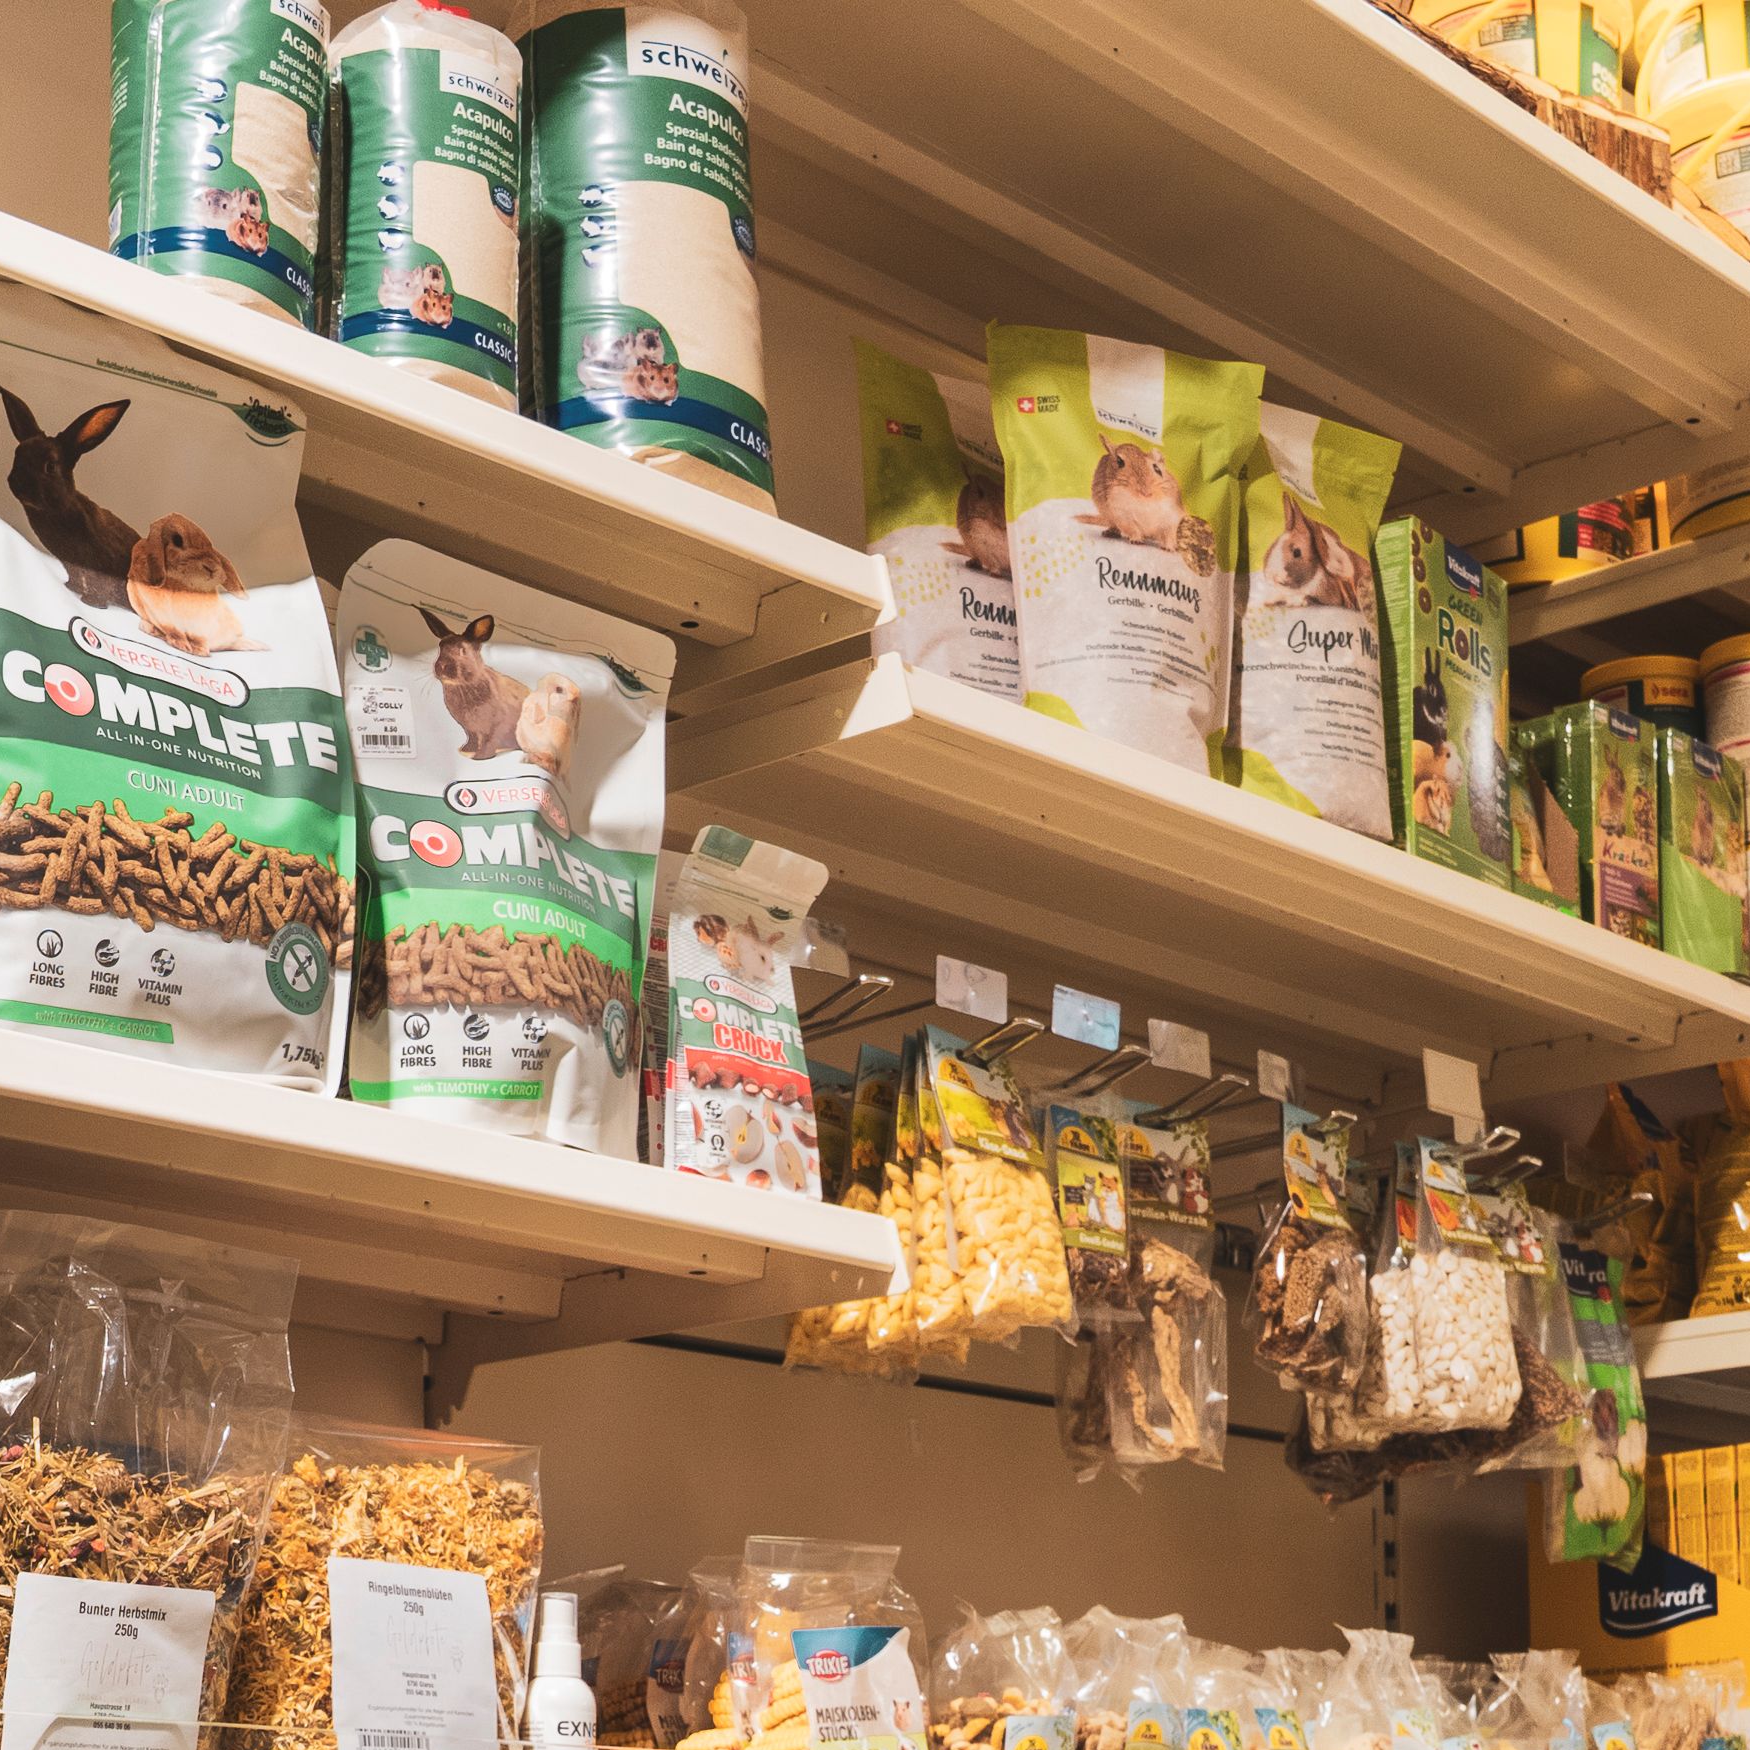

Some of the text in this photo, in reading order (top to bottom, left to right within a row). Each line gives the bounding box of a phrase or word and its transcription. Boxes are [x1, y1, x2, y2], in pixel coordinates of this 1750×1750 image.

[449, 74, 514, 112] schweizer
[453, 101, 513, 143] Acapulco
[669, 93, 744, 147] Acapulco
[657, 137, 730, 172] Bain de sable
[1037, 396, 1061, 404] SWISS
[1037, 404, 1059, 413] MADE
[1098, 409, 1158, 438] schweizer
[1095, 557, 1202, 614] Rennmaus
[969, 627, 1005, 642] Gerbille
[1437, 607, 1492, 679] Rolls
[2, 650, 338, 775] COMPLETE
[96, 727, 262, 780] ALL-IN-ONE NUTRITION
[370, 815, 635, 922] COMPLETE
[461, 872, 595, 913] ALL-IN-ONE NUTRITION
[493, 901, 587, 940] CUNI ADULT
[32, 962, 64, 976] LONG
[91, 970, 119, 985] HIGH
[29, 973, 65, 989] FIBRES
[89, 982, 118, 998] FIBRE
[138, 978, 183, 996] VITAMIN
[145, 993, 171, 1007] PLUS
[401, 1045, 434, 1057] LONG
[462, 1046, 492, 1058] HIGH
[713, 1022, 788, 1065] CROCK
[399, 1055, 437, 1069] FIBRES
[461, 1057, 493, 1070] FIBRE
[520, 1057, 544, 1071] PLUS
[368, 1580, 453, 1601] Ringelblumenblüten
[1607, 1583, 1706, 1614] Vitakraft
[79, 1601, 166, 1622] Bunter Herbstmix
[403, 1601, 424, 1616] 250g
[114, 1623, 139, 1640] 250g
[806, 1655, 849, 1676] TRIXIE
